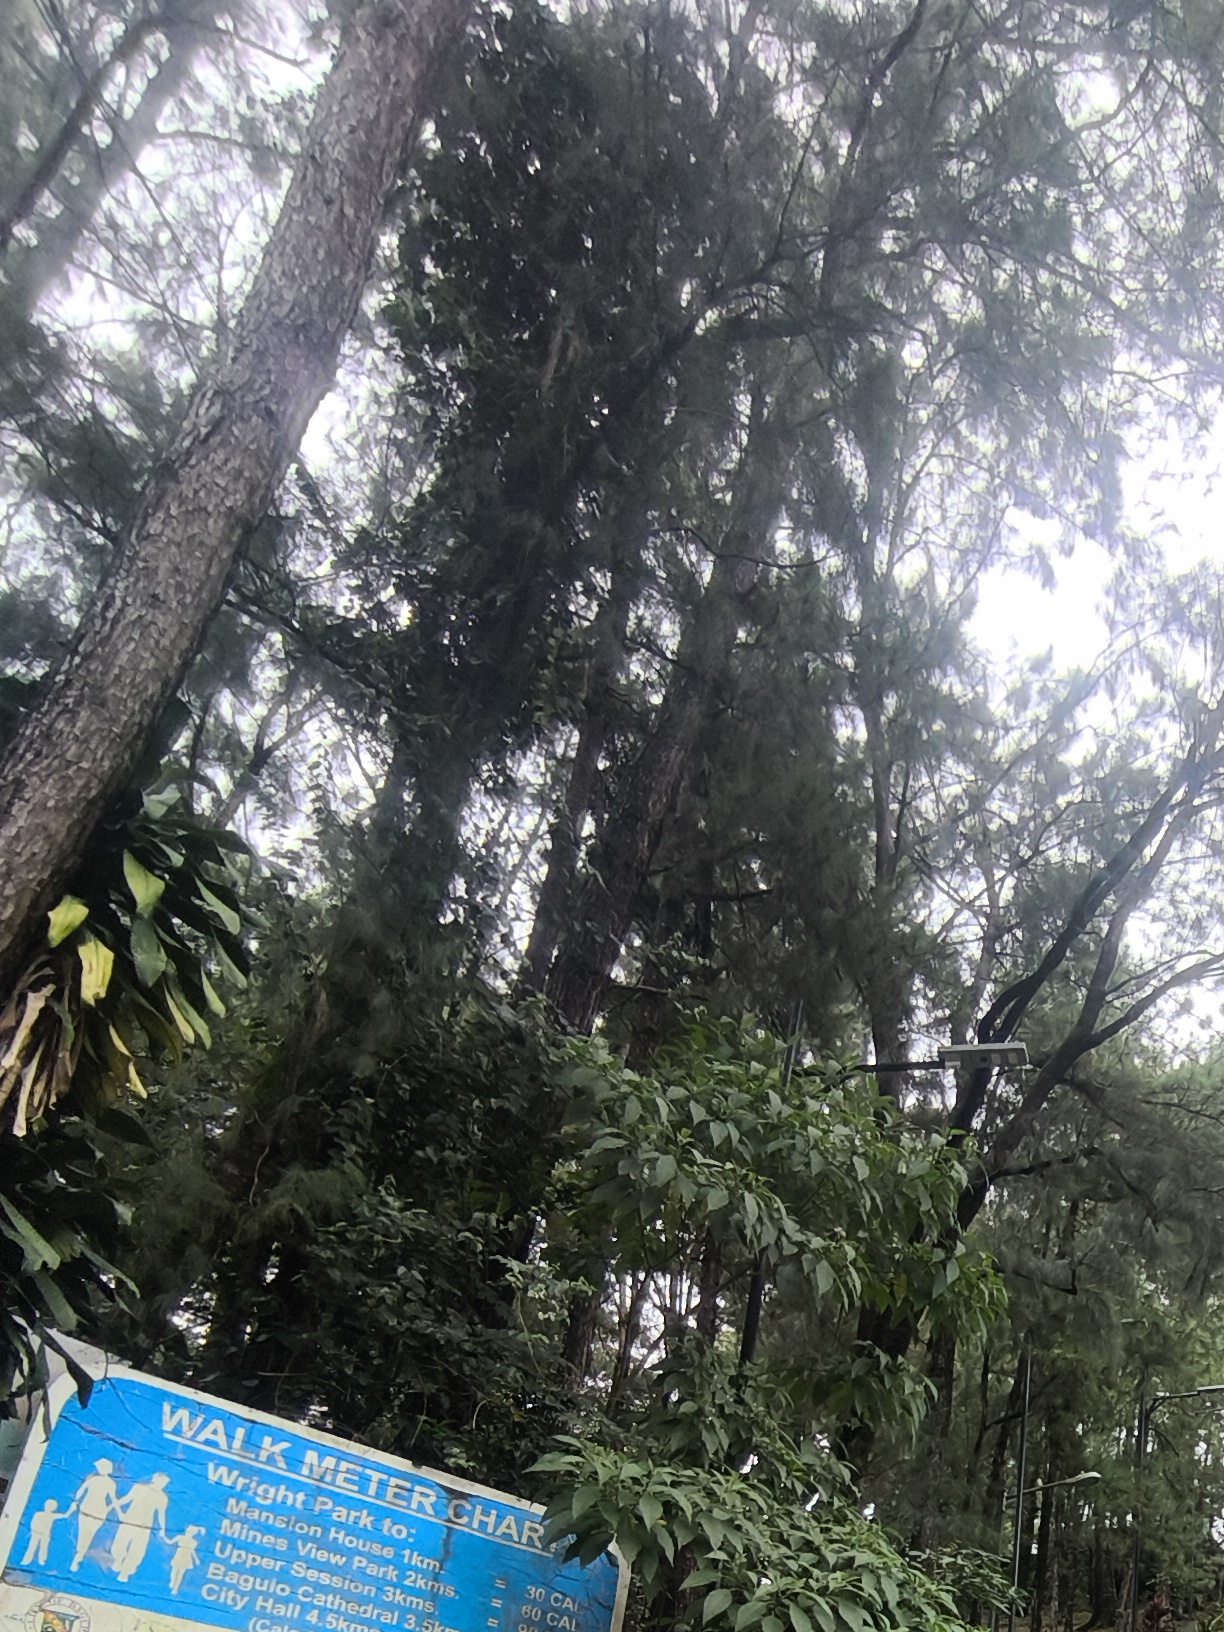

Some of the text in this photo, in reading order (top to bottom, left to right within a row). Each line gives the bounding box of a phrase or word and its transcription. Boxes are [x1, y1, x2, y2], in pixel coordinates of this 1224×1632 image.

[162, 1400, 293, 1469] WALK
[300, 1449, 438, 1516] METER
[208, 1461, 417, 1543] Wright Park to:
[214, 1540, 287, 1572] Upper
[290, 1561, 377, 1598] Session
[382, 1585, 439, 1615] 3kms.
[219, 1519, 289, 1551] Mines
[297, 1538, 347, 1567] View
[352, 1555, 400, 1582] Park
[402, 1570, 460, 1600] 2kms.
[521, 1605, 542, 1622] 60
[226, 1497, 323, 1538] Mansion
[329, 1526, 396, 1559] House
[402, 1548, 446, 1574] 1km.
[525, 1584, 546, 1602] 30
[201, 1583, 250, 1611] City
[255, 1595, 300, 1619] Hall
[206, 1562, 291, 1597] Baguio
[298, 1585, 399, 1625] Cathedral
